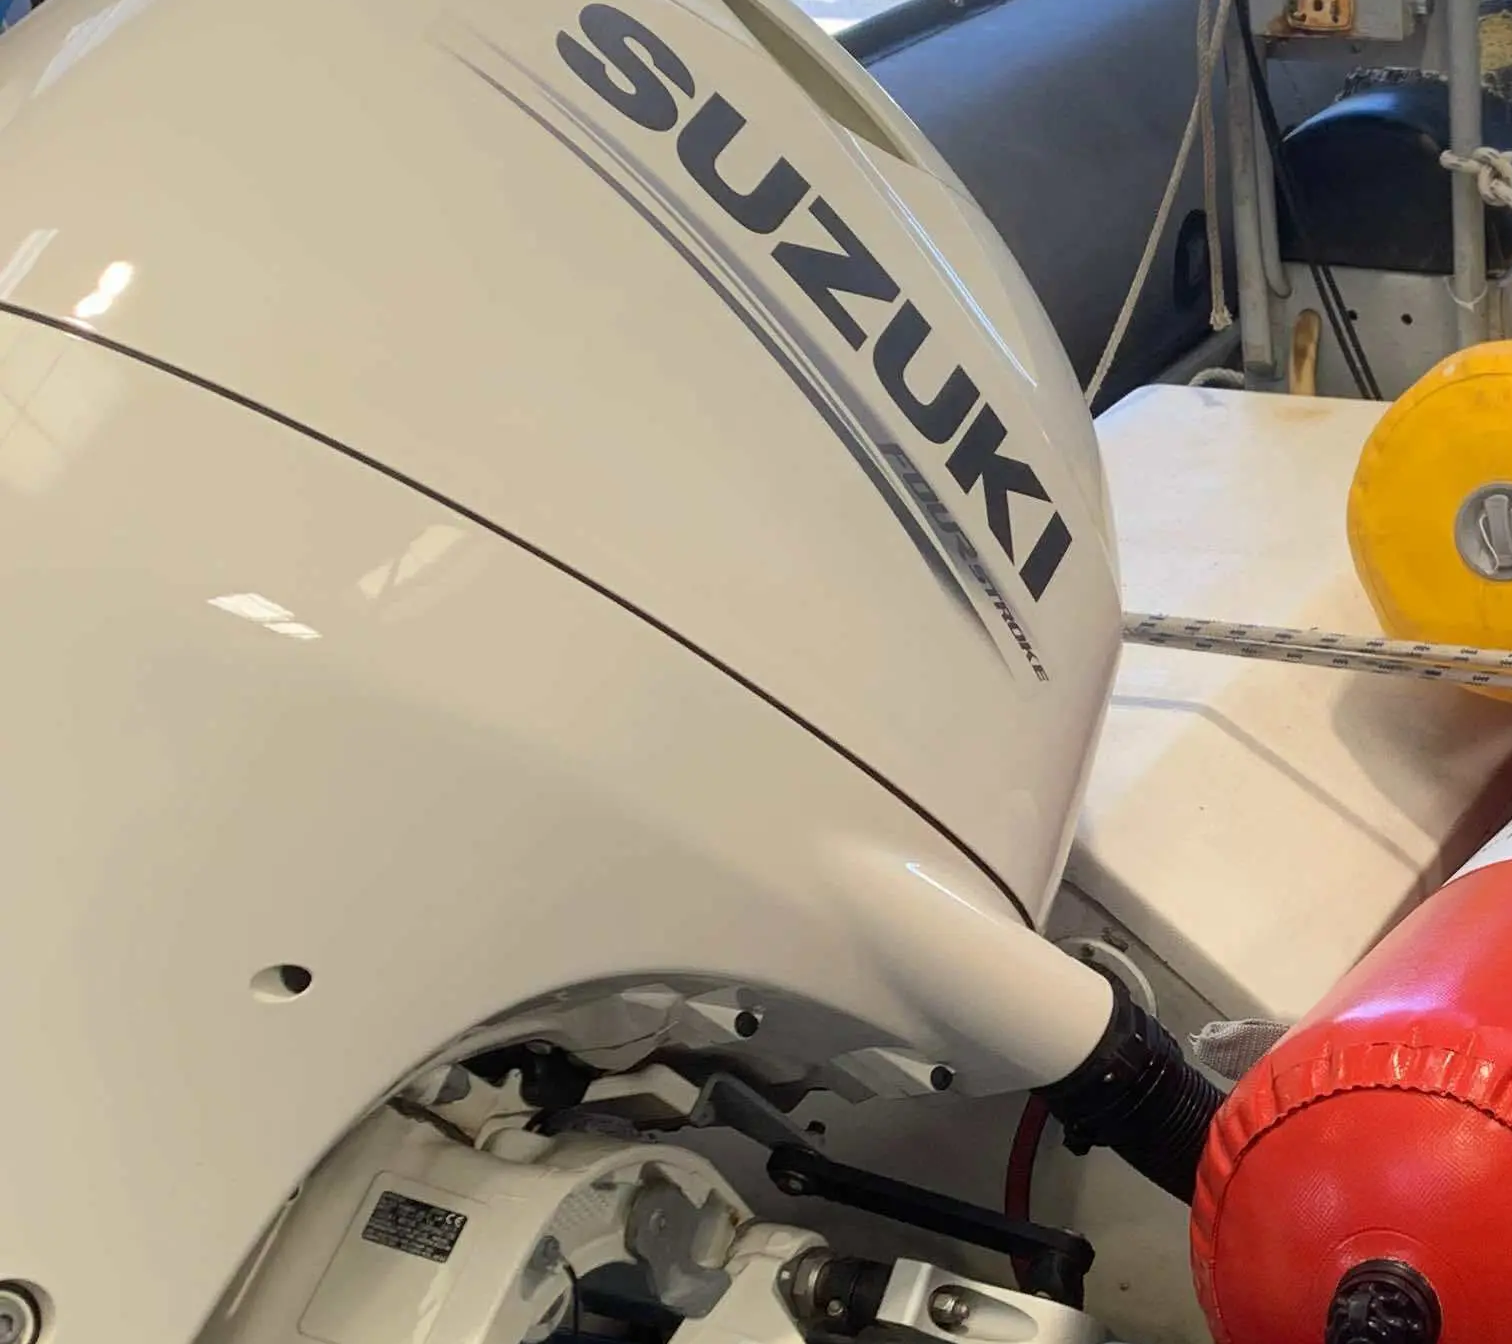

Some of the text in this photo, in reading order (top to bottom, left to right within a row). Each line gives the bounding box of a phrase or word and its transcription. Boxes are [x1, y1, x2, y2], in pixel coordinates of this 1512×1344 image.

[556, 3, 1072, 602] SUZUKI
[877, 442, 1050, 682] FOUR STROKE
